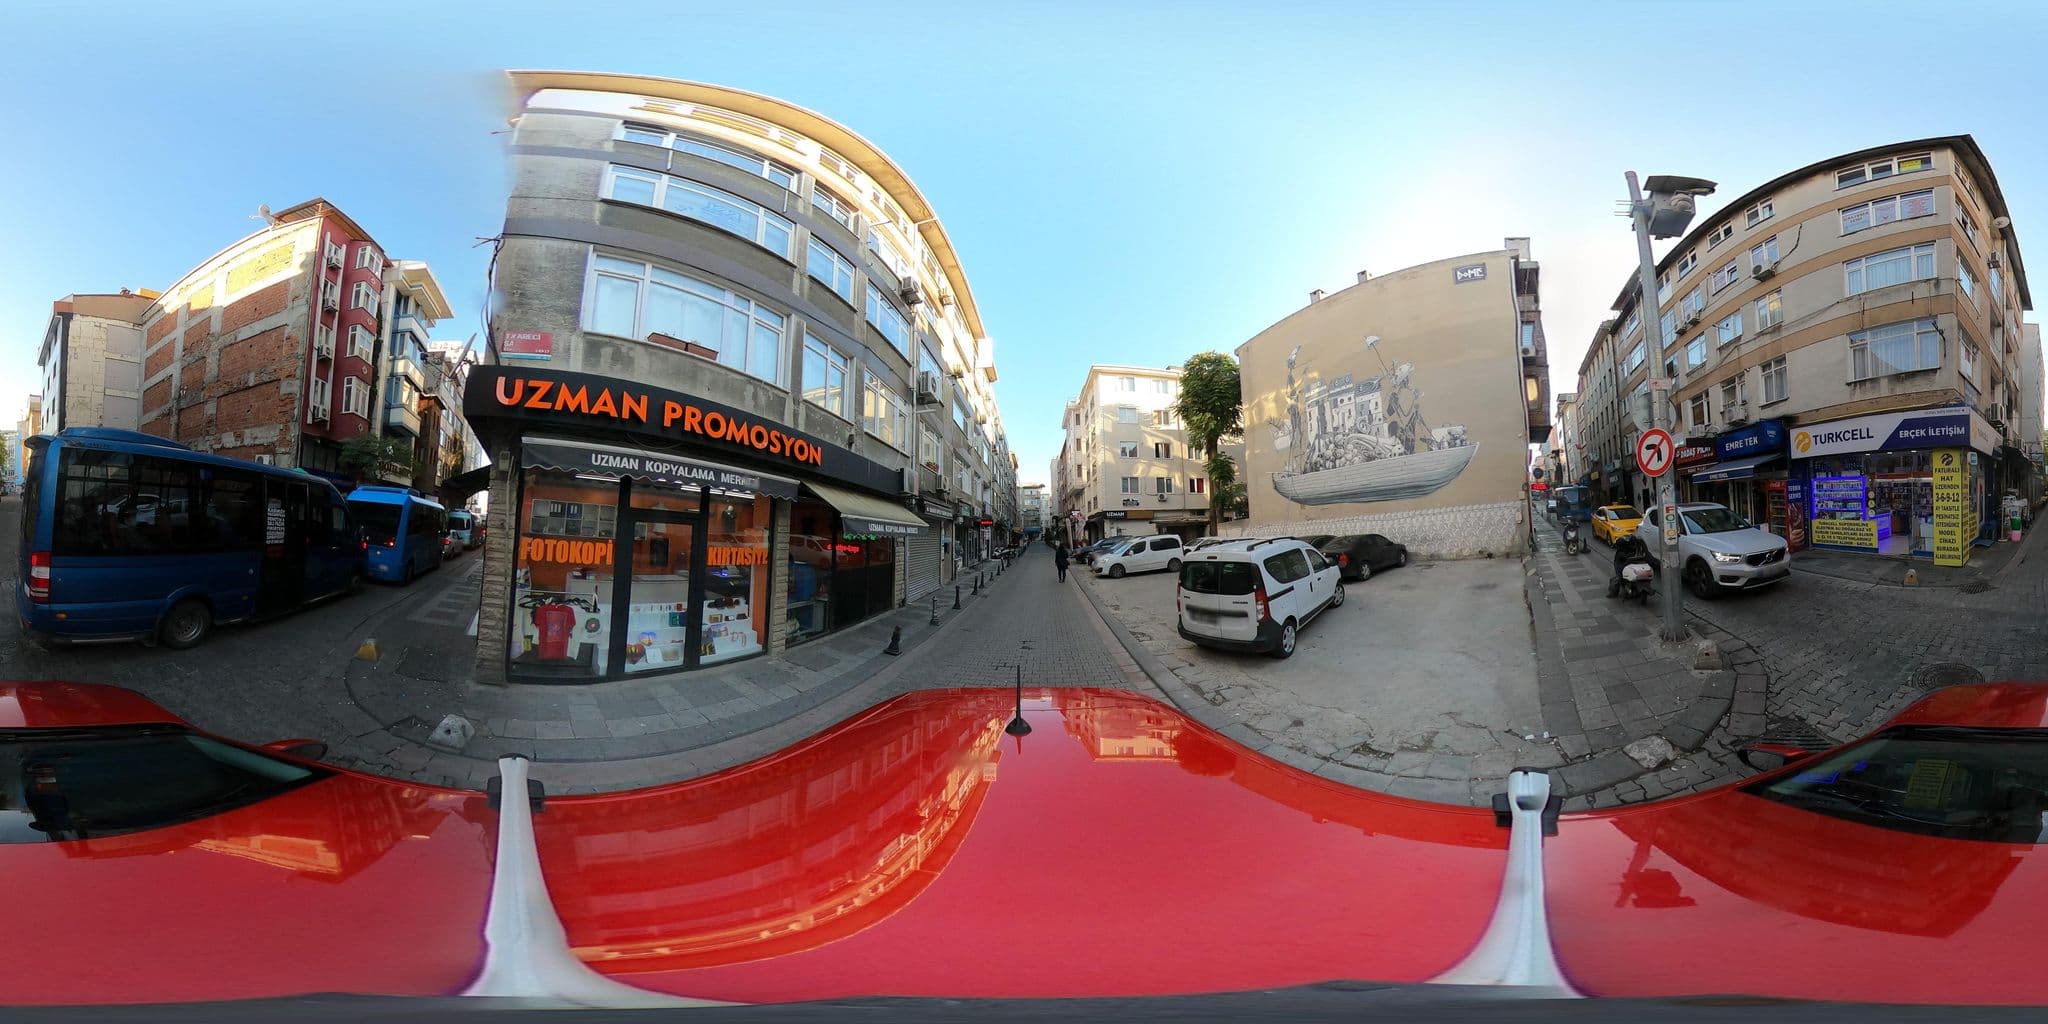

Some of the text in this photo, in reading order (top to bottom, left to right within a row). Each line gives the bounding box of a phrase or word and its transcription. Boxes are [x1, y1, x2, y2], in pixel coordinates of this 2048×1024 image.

[495, 376, 822, 466] UZMAN PROMOSYON
[1900, 428, 1926, 439] ERÇEK
[1928, 425, 1965, 437] İLETİŞİM
[1725, 436, 1759, 451] EMRE TEK
[1812, 427, 1874, 446] TURKCELL
[591, 453, 639, 470] UZMAN
[645, 460, 715, 481] KOPYALAMA
[520, 537, 613, 565] FOTOKOPİ
